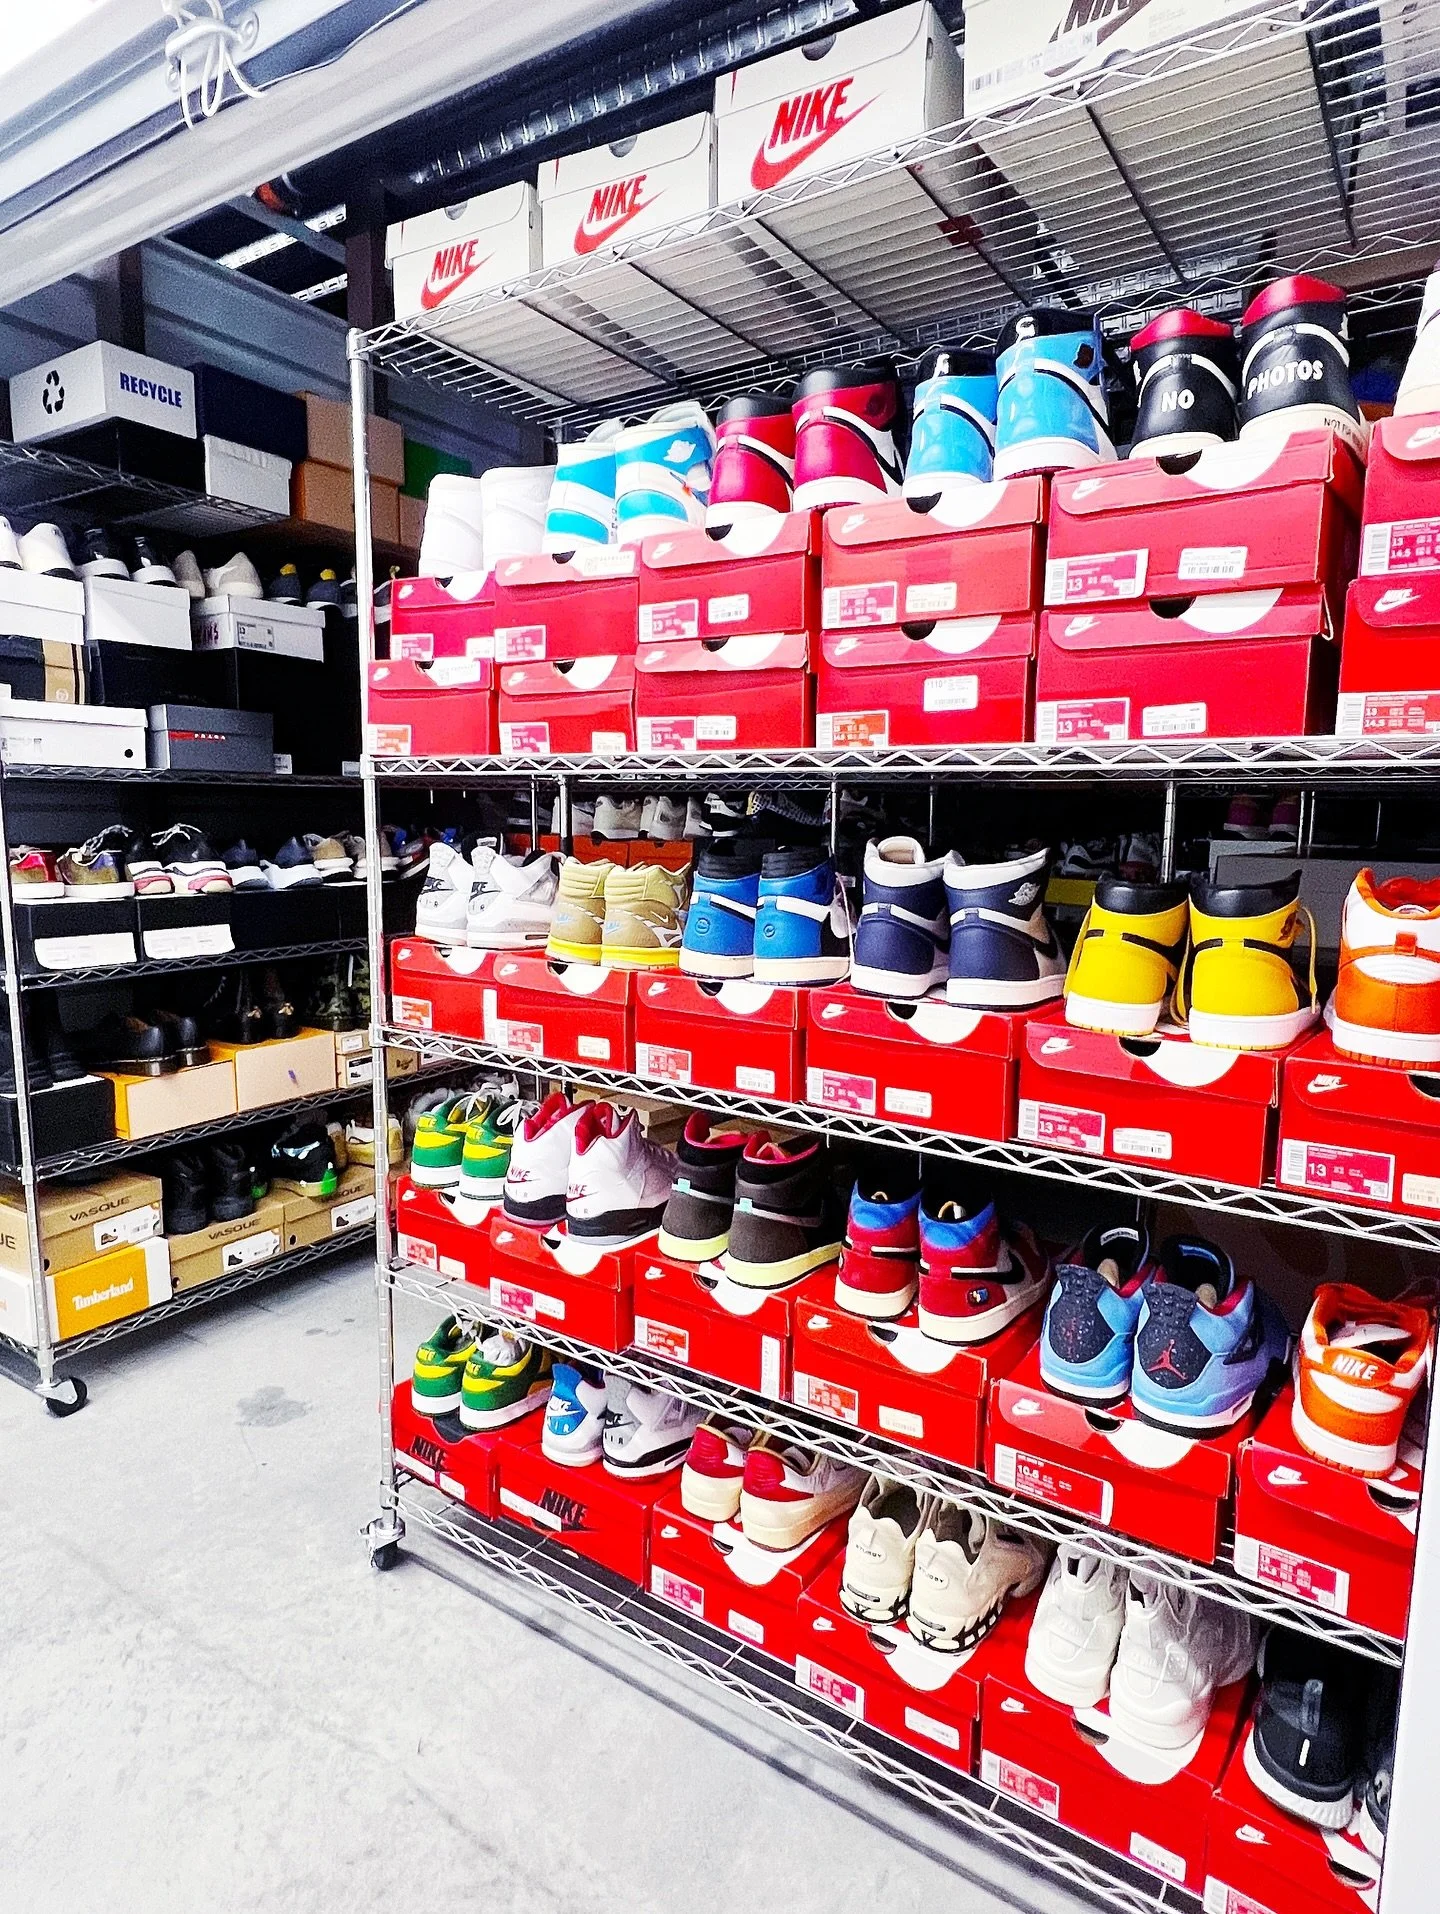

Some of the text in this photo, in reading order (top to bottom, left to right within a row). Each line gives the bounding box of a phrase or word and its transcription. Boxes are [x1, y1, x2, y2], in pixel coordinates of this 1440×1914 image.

[767, 76, 855, 147] NIKE
[586, 174, 648, 224] NIKE
[431, 238, 480, 280] NIKE
[119, 372, 183, 409] RECYCLE
[1247, 359, 1324, 400] PHOTOS
[1161, 388, 1195, 413] NO
[1067, 577, 1083, 592] 13
[1057, 721, 1073, 734] 13
[1039, 1121, 1054, 1134] 13
[510, 1165, 531, 1179] NIKE
[1308, 1162, 1327, 1177] 13
[568, 1184, 588, 1194] NIKE
[69, 1196, 132, 1222] VASQUE
[208, 1217, 261, 1241] VASQUE
[72, 1277, 134, 1312] Timberland
[1333, 1353, 1379, 1381] NIKE
[413, 1435, 448, 1470] NIKE
[541, 1487, 588, 1526] NIKE
